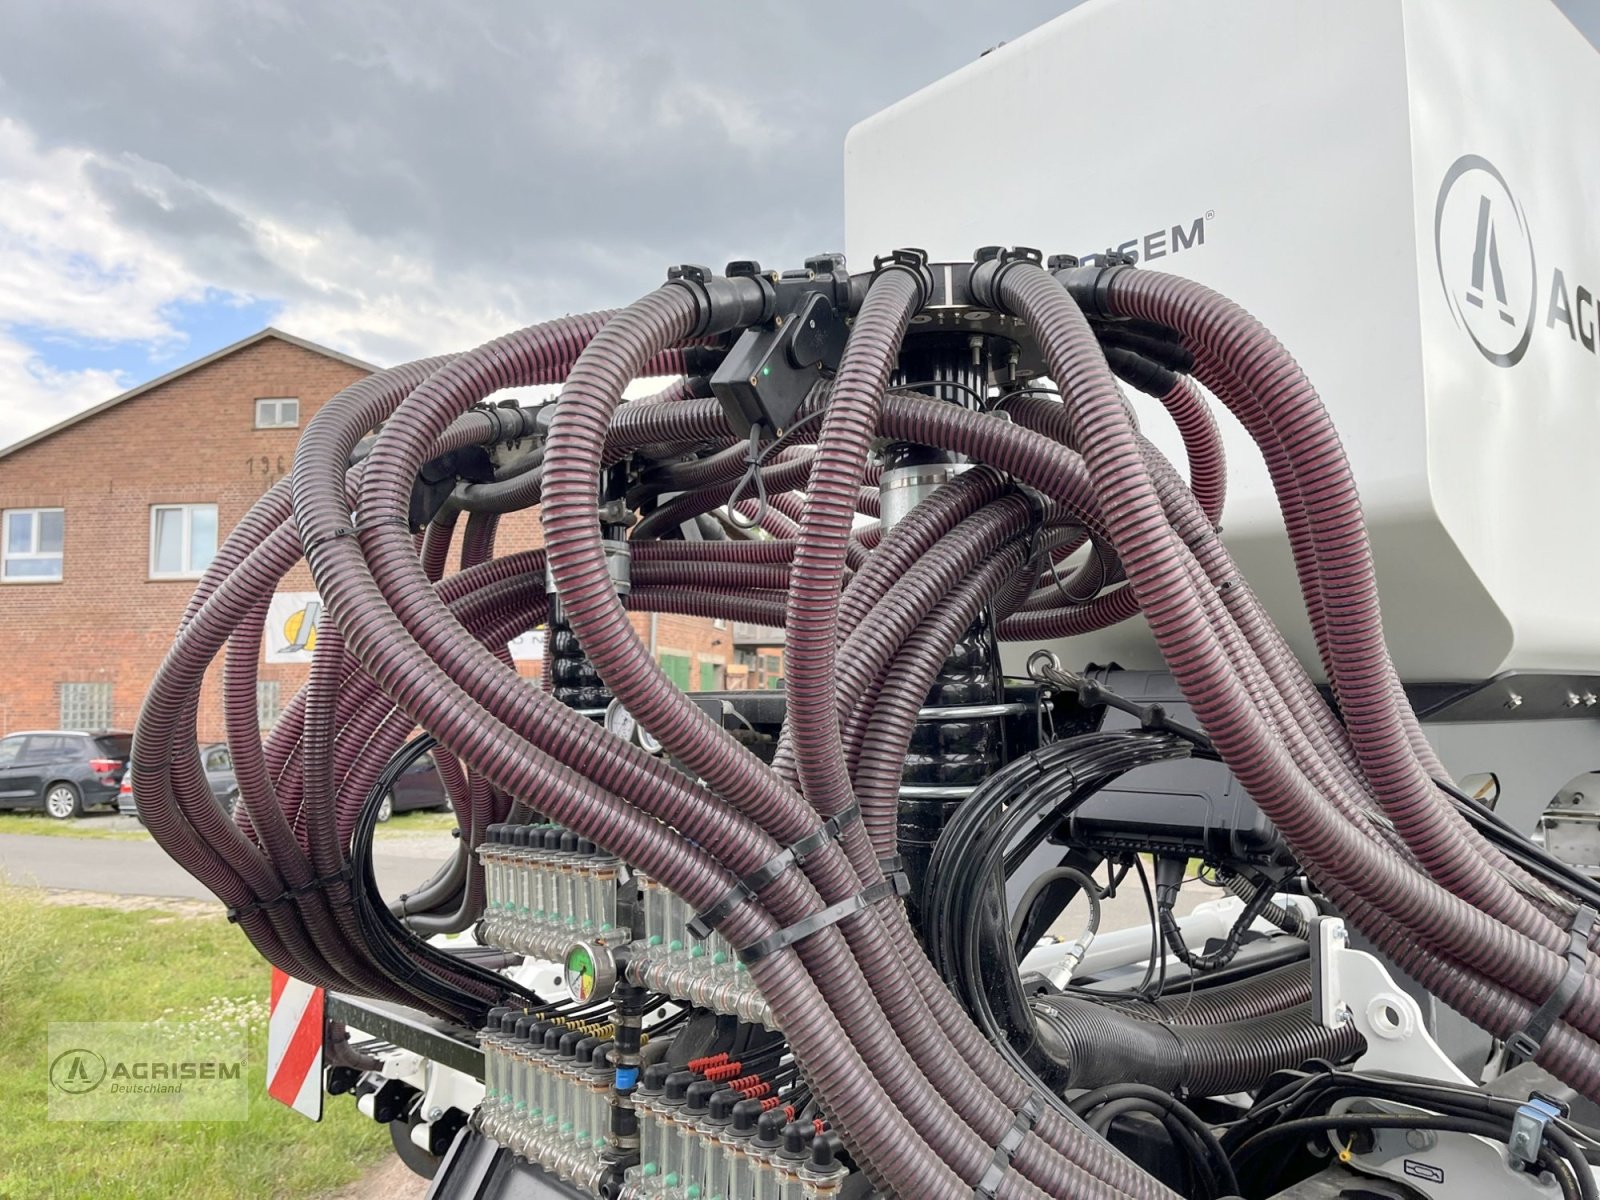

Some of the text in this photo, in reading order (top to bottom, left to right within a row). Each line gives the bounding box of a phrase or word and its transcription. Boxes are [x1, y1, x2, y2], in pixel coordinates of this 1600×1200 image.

[1079, 217, 1206, 268] SEM
[1546, 266, 1600, 355] AG
[245, 455, 291, 476] 196
